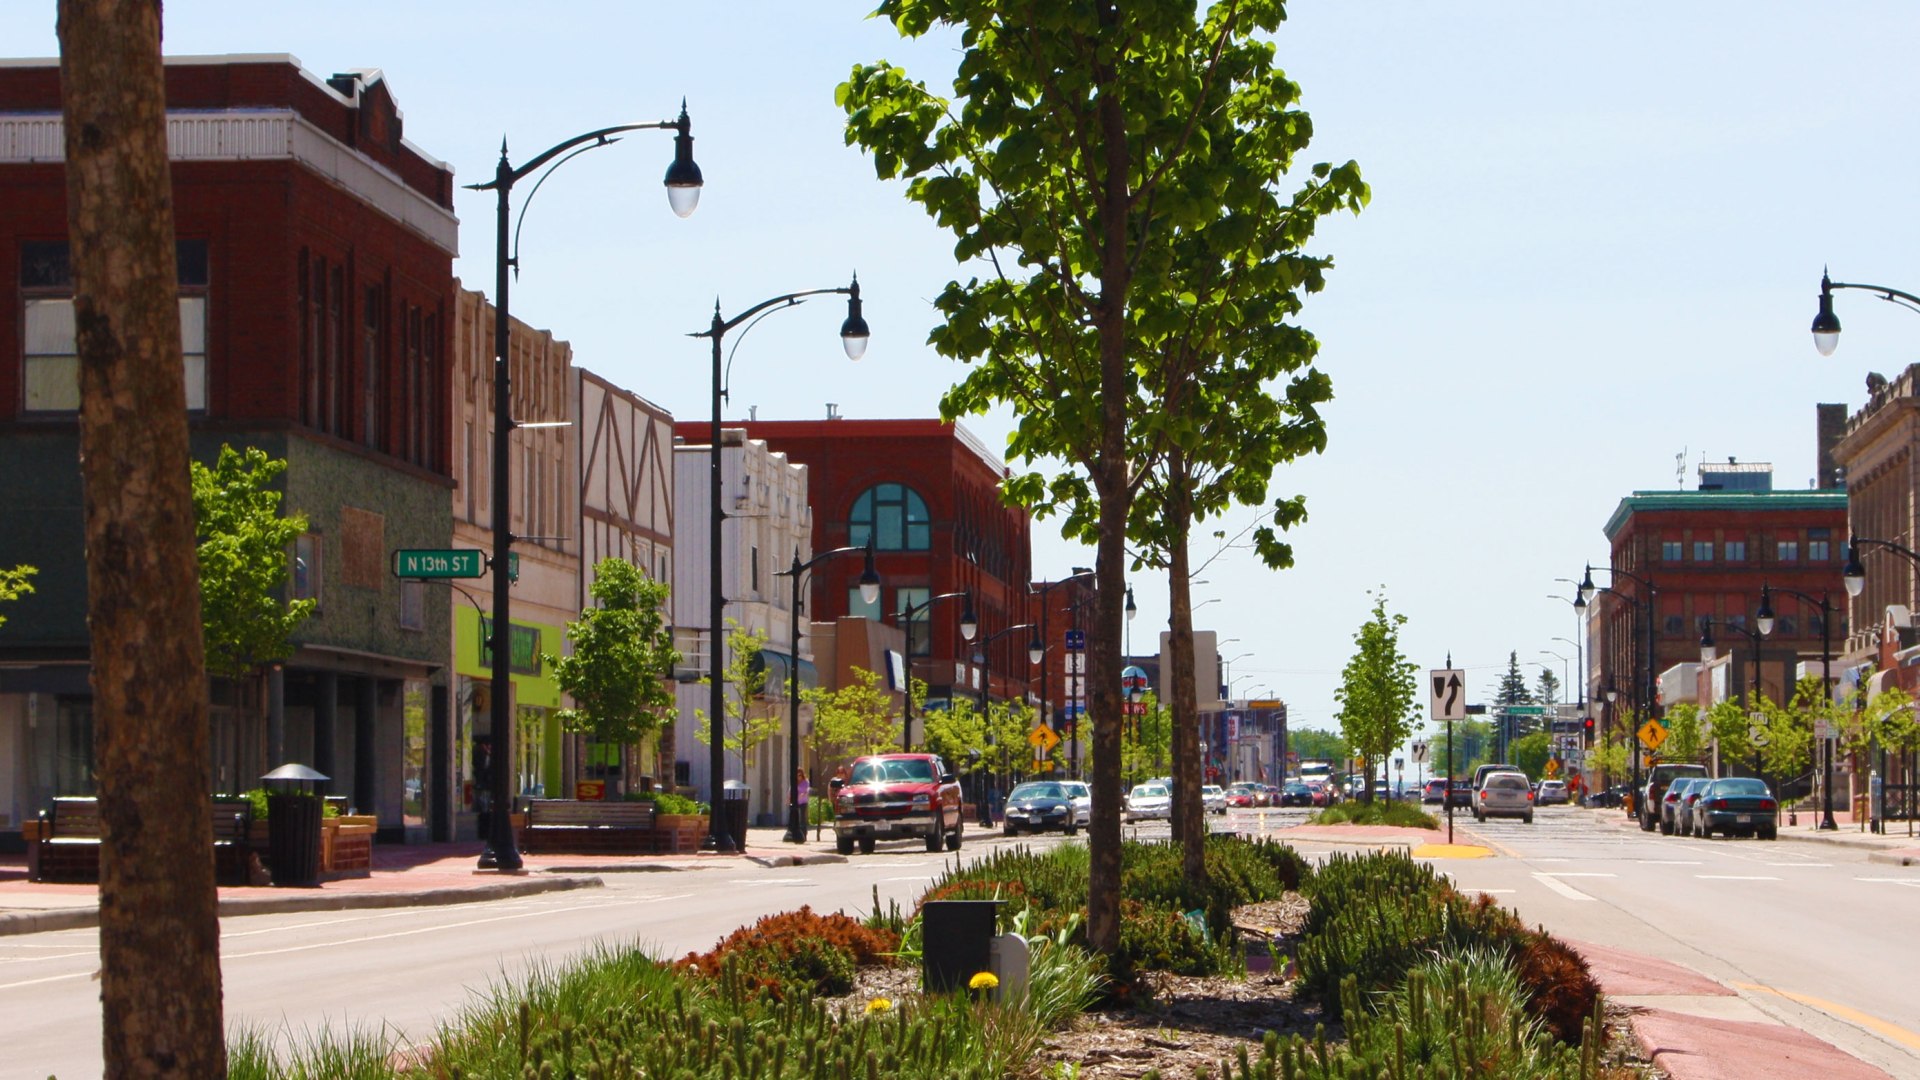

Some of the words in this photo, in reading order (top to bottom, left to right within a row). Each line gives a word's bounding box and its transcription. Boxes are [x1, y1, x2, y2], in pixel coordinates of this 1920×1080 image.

[408, 557, 417, 571] N
[421, 556, 448, 572] 13th
[451, 556, 469, 572] ST
